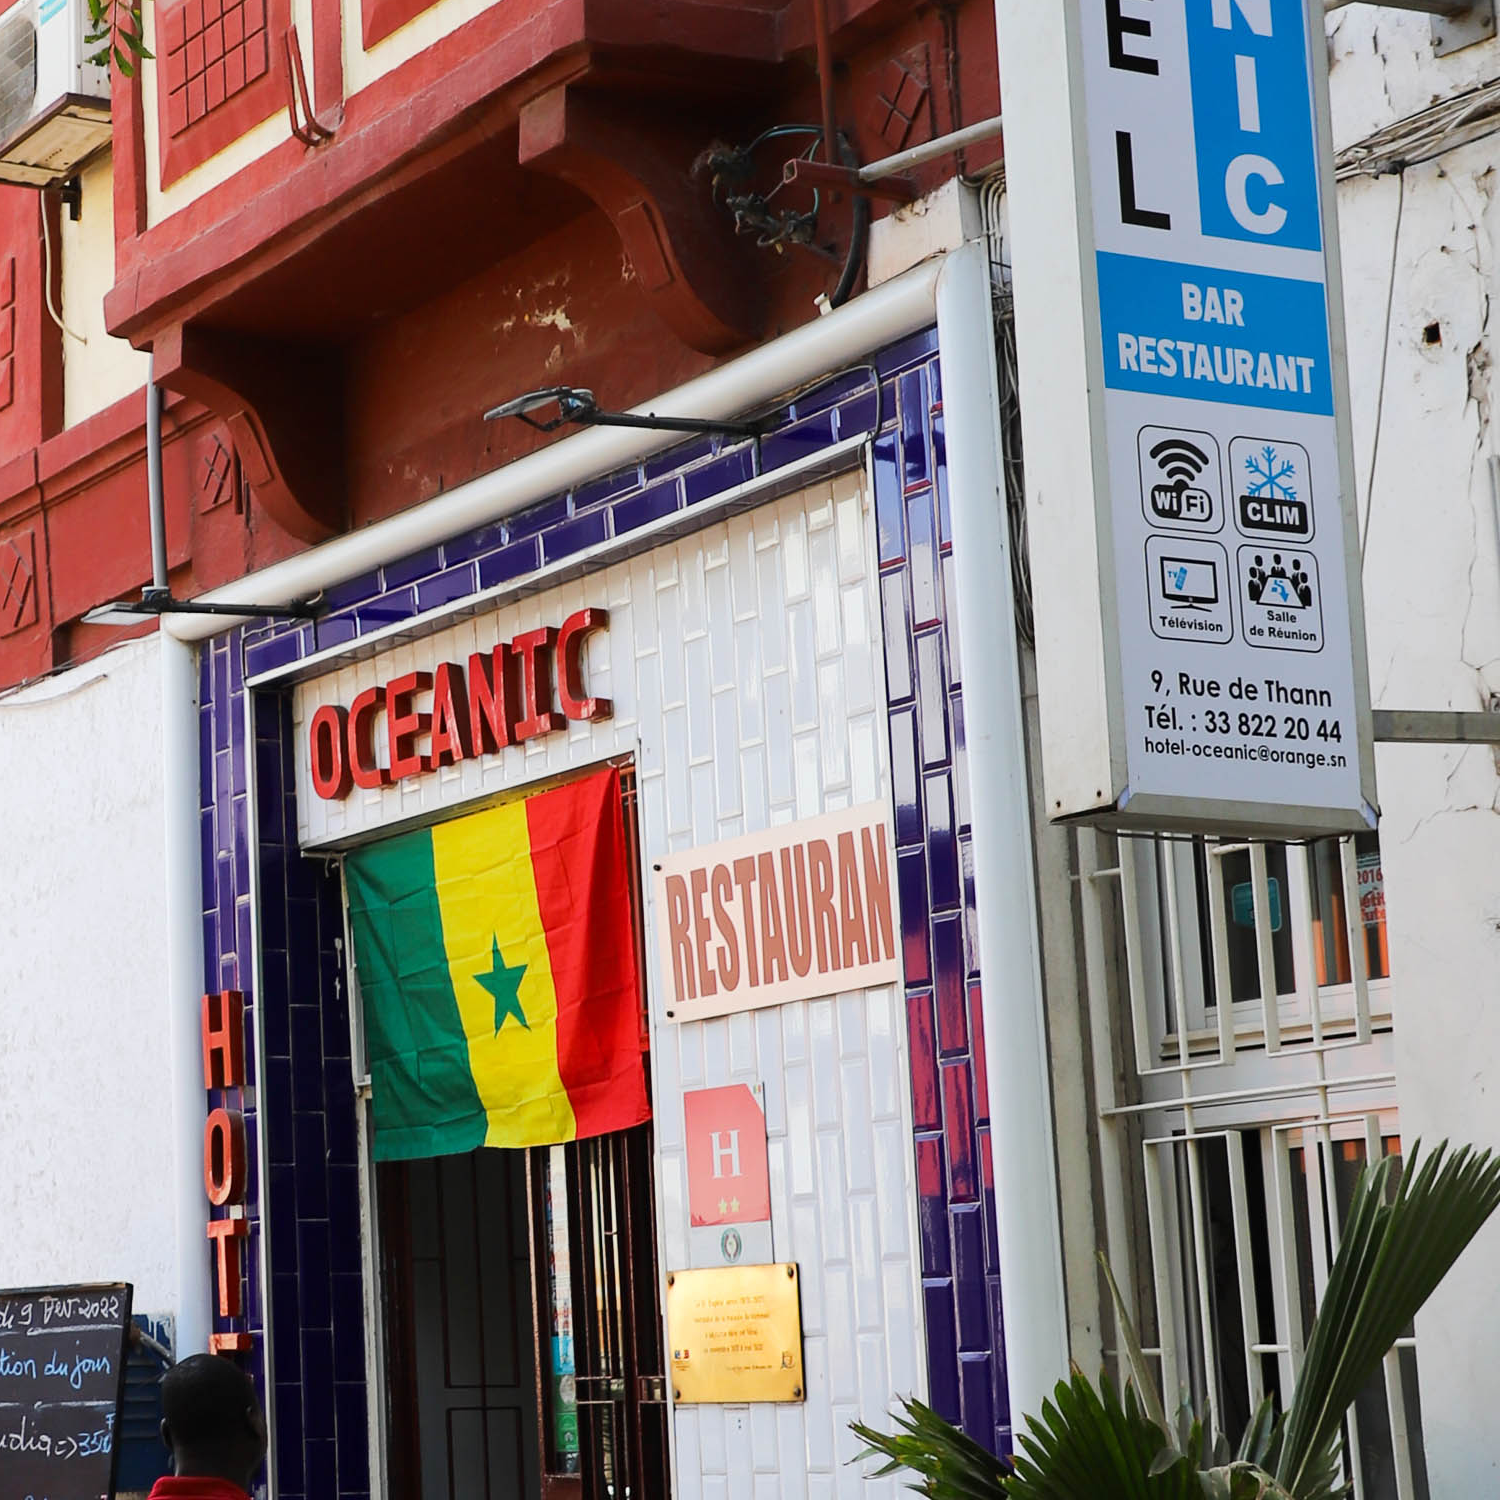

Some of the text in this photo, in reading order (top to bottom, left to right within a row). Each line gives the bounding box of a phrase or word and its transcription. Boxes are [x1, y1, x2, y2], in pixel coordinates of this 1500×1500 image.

[1181, 282, 1244, 327] BAR
[1117, 332, 1315, 394] RESTAURANT
[1247, 502, 1300, 526] CLIM
[1159, 615, 1223, 632] Télévision
[1249, 625, 1317, 642] de Réunion
[1267, 610, 1297, 623] Salle
[309, 607, 614, 800] OCEANIC
[1178, 672, 1221, 698] Rue
[1228, 677, 1258, 701] de
[1264, 680, 1332, 707] Thann
[1144, 704, 1183, 731] Tél.
[1204, 710, 1231, 735] 33
[1238, 713, 1277, 738] 822
[1284, 717, 1310, 741] 20
[1317, 720, 1342, 743] 44
[1144, 737, 1347, 769] hotel-oceanic@orange.sn
[665, 823, 896, 1002] RESTAURAN
[201, 989, 248, 1358] HOT
[710, 1129, 743, 1179] H
[44, 1350, 68, 1376] du
[69, 1340, 112, 1389] jour
